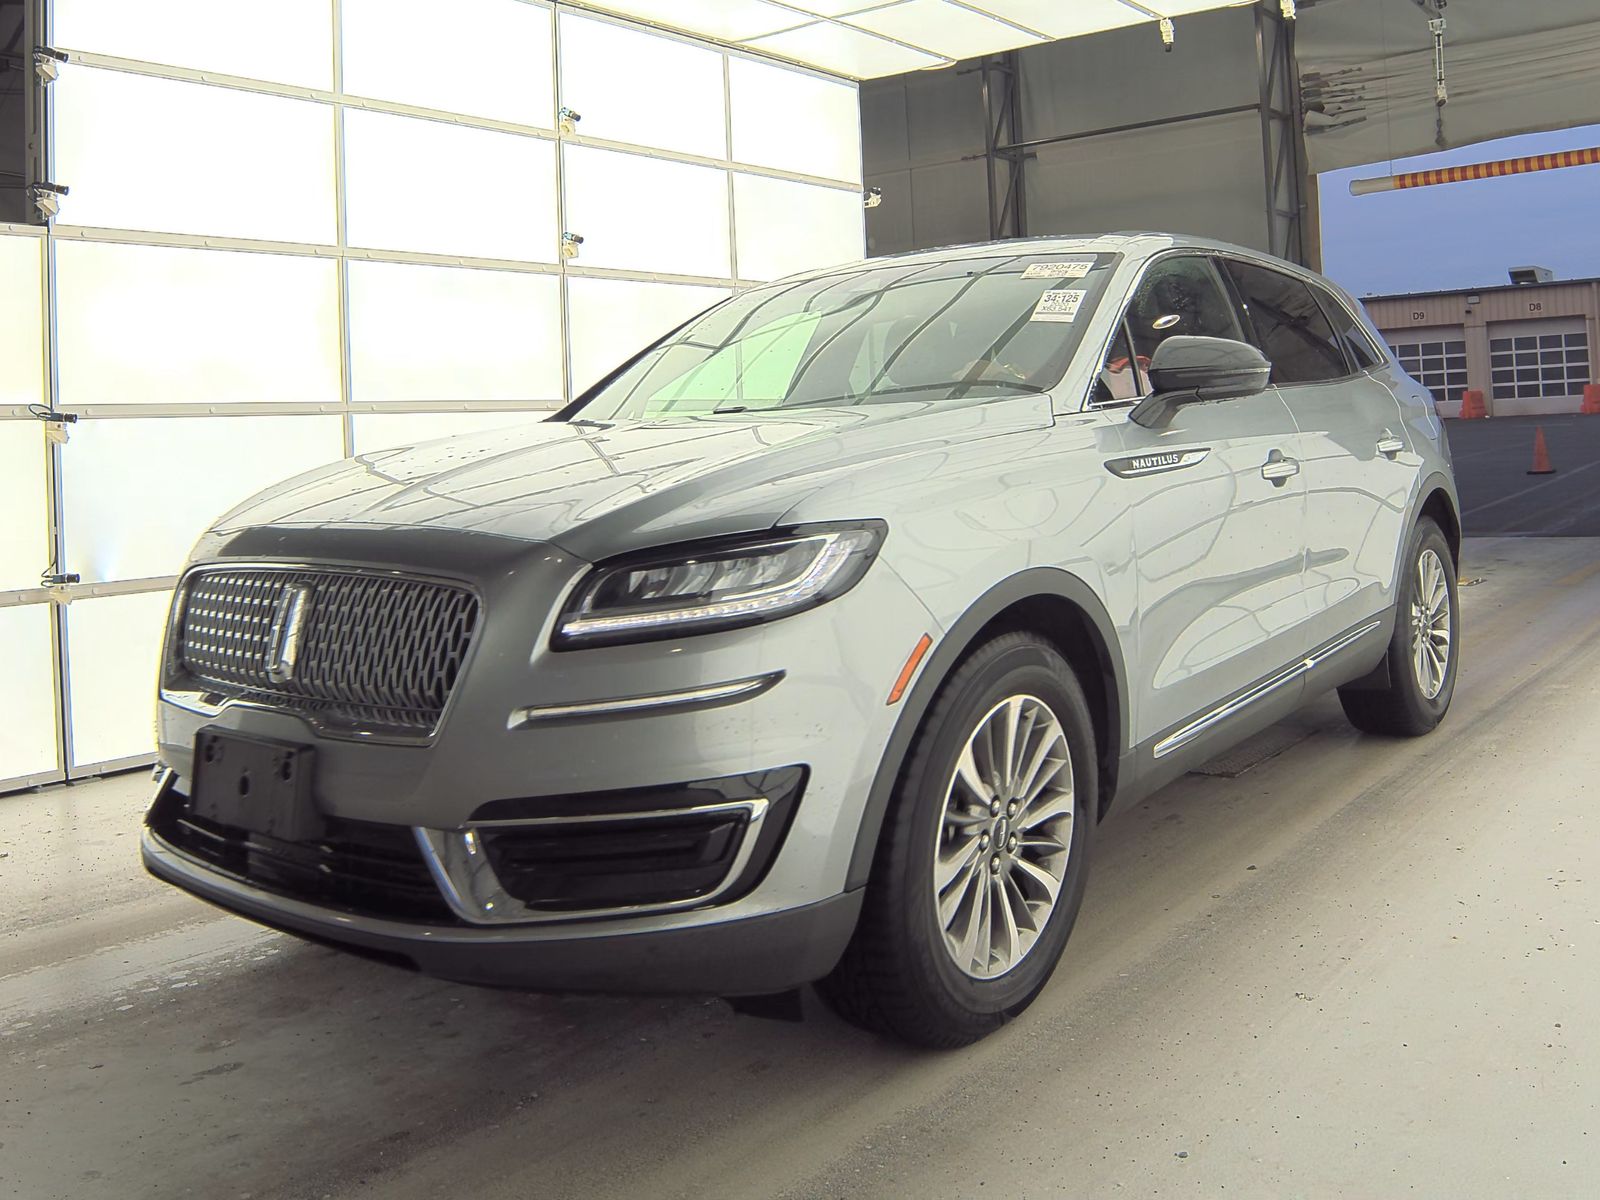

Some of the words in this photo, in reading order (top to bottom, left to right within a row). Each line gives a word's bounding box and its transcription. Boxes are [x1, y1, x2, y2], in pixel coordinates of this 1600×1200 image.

[1529, 303, 1542, 312] D8
[1412, 311, 1425, 320] D9
[1132, 453, 1179, 469] NAUTILUS
